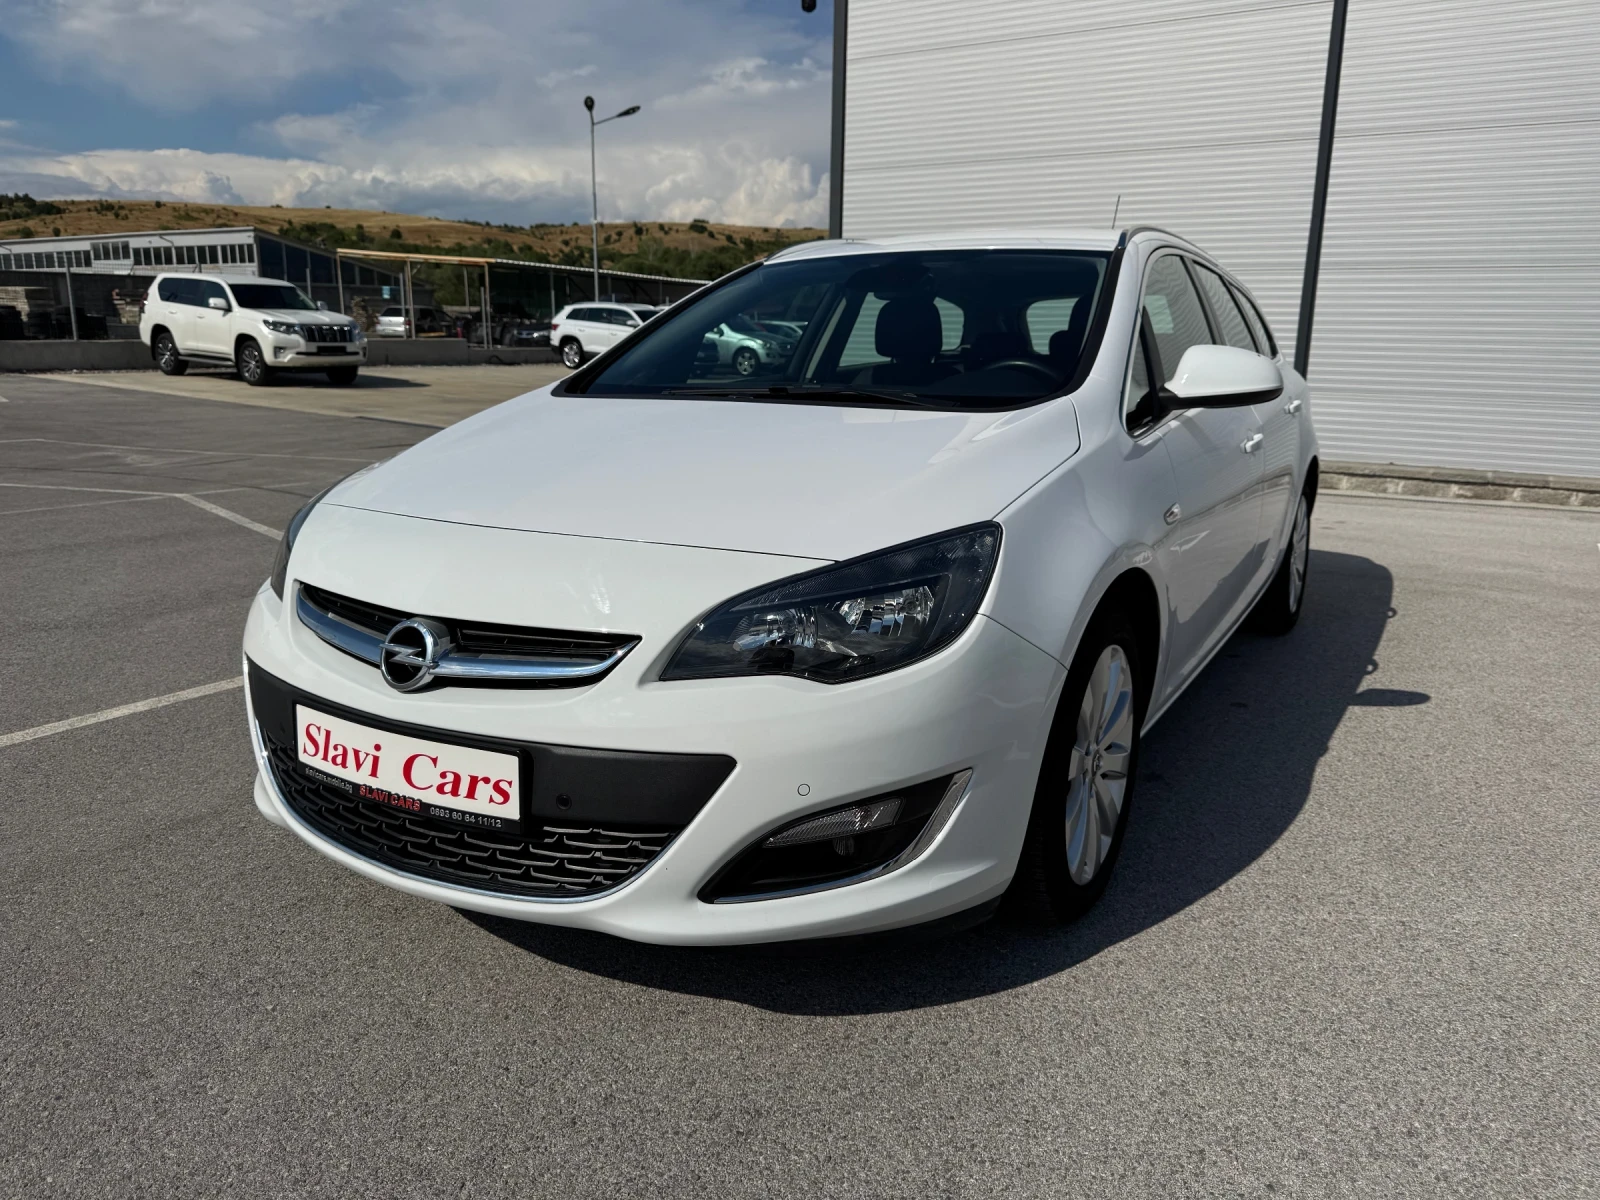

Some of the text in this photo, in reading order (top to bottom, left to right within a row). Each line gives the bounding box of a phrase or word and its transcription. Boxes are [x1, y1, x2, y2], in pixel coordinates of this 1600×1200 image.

[303, 723, 513, 806] Slavi Cars
[359, 785, 421, 812] SLAVI CARS
[452, 811, 462, 820] 60
[464, 814, 476, 823] 64
[477, 816, 502, 828] 11/12
